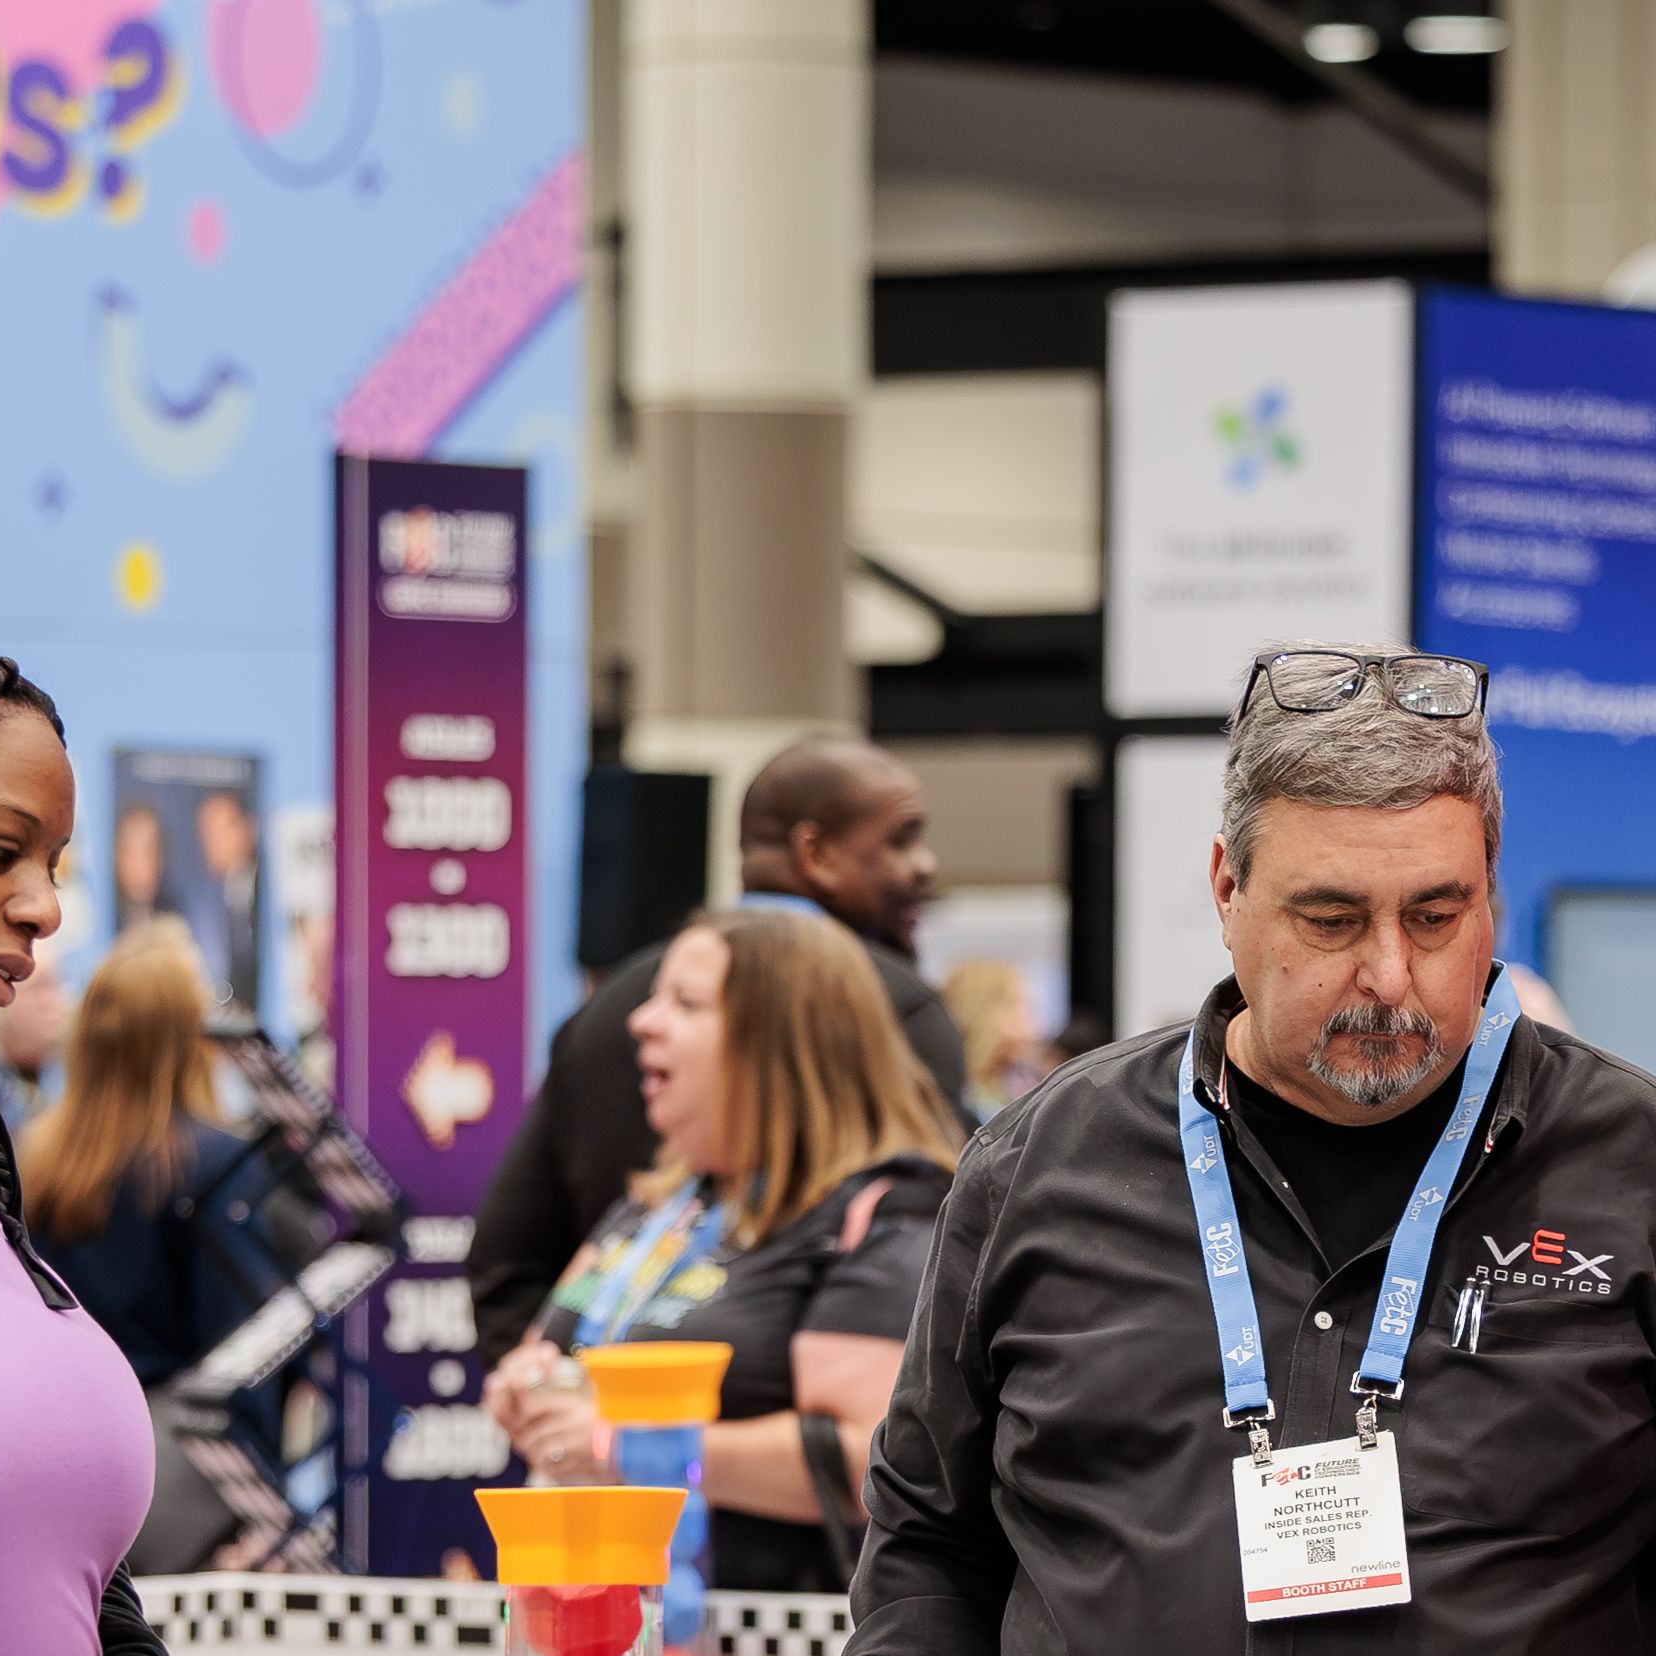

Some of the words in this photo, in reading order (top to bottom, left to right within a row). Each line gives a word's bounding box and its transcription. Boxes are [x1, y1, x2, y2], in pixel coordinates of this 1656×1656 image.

[1482, 1228, 1615, 1281] VEX
[1475, 1264, 1612, 1295] ROBOTICS
[1295, 1485, 1337, 1499] KEITH
[1273, 1496, 1361, 1517] NORTHCUTT
[1264, 1517, 1302, 1531] INSIDE
[1305, 1512, 1343, 1524] SALES
[1345, 1509, 1373, 1519] REP.
[1276, 1529, 1299, 1540] VEX
[1302, 1521, 1362, 1537] ROBOTICS
[1350, 1559, 1401, 1574] newline
[1281, 1583, 1326, 1598] BOOTH
[1328, 1578, 1368, 1592] STAFF
